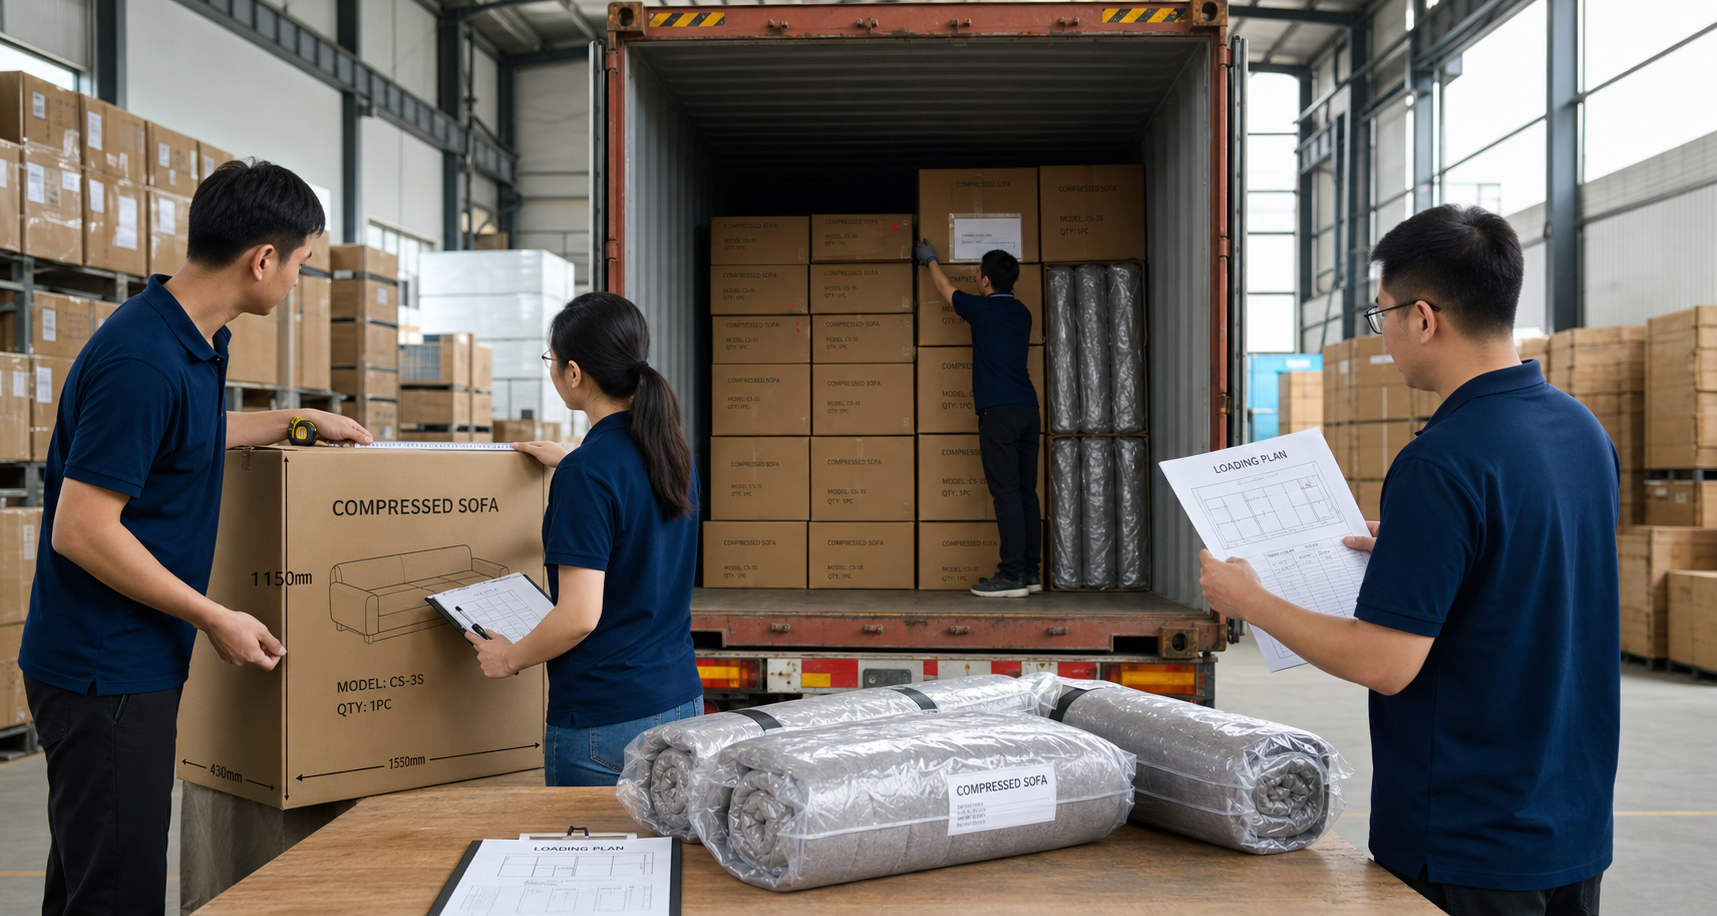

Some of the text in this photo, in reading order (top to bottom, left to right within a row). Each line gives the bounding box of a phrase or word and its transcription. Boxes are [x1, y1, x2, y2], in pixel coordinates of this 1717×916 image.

[942, 390, 968, 398] MODEL:
[942, 402, 958, 410] QTY:
[1213, 450, 1288, 474] LOADING PLAN
[332, 497, 500, 518] COMPRESSED SOFA
[252, 570, 312, 586] 1150mm
[337, 674, 424, 694] MODEL: CS-3S
[337, 698, 392, 717] QTY: 1PC
[388, 754, 426, 770] 1550mm
[210, 764, 243, 784] 430mm
[956, 774, 1048, 796] COMPRESSED SOFA
